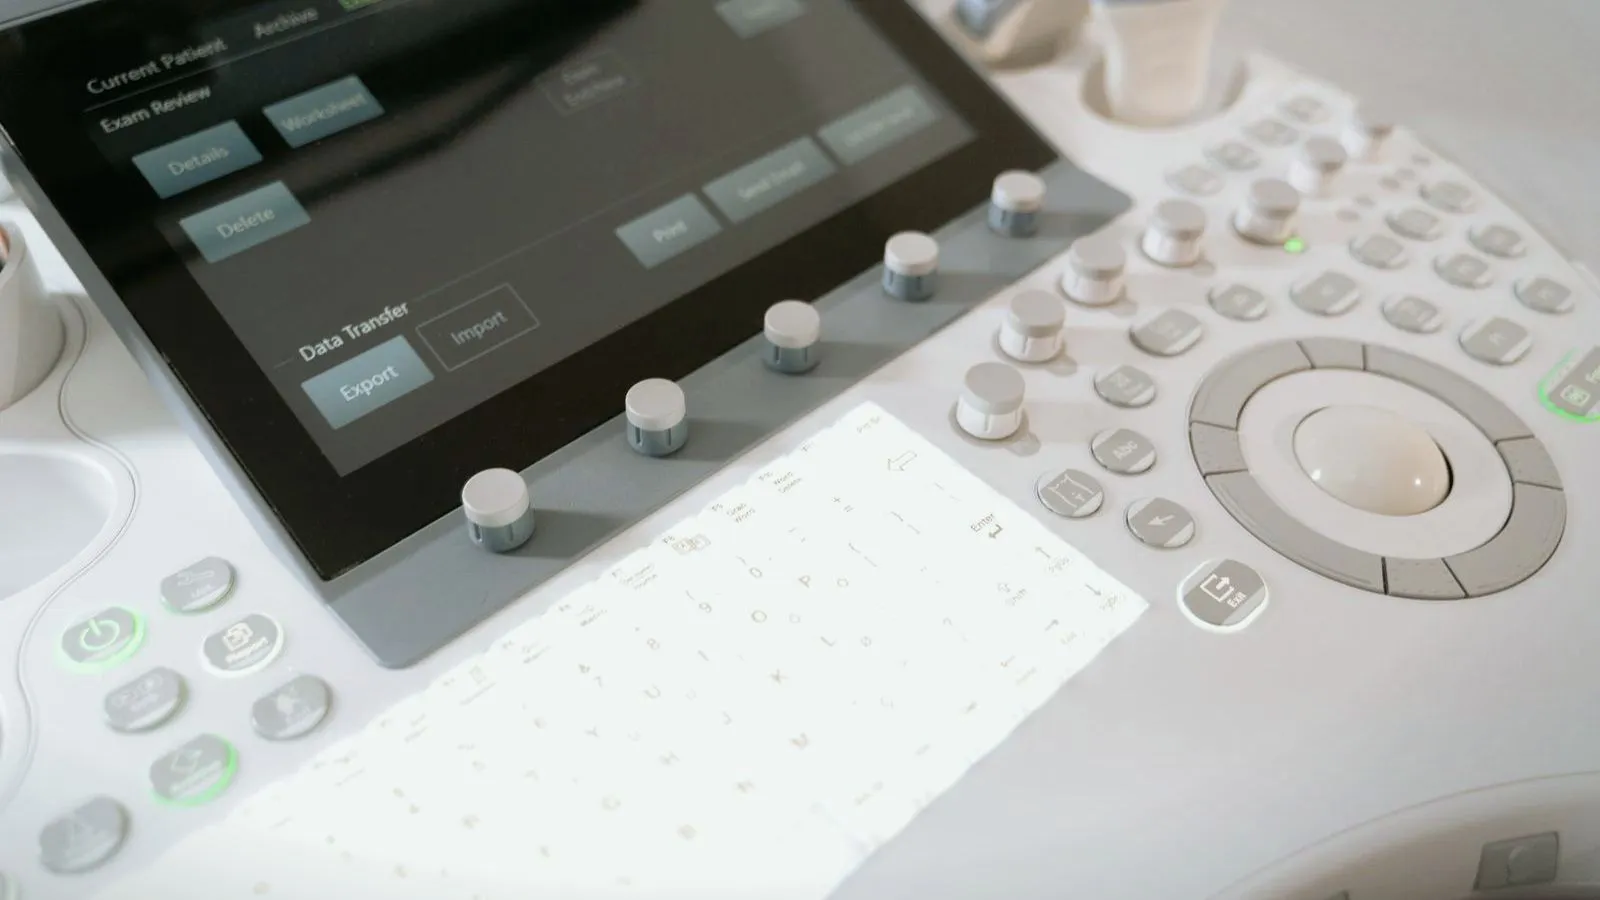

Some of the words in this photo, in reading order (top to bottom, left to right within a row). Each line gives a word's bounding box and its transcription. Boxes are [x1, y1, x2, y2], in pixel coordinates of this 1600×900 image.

[253, 7, 319, 39] Archive
[86, 59, 161, 95] Current
[161, 37, 228, 70] Patient
[100, 106, 150, 135] Exam
[150, 85, 211, 116] Review
[280, 91, 368, 133] Worksheet
[168, 145, 230, 176] Details
[216, 206, 276, 239] Delete
[298, 334, 344, 363] Data
[342, 301, 410, 342] Transfer
[450, 310, 509, 347] Import
[339, 364, 400, 403] Export
[970, 512, 995, 532] Enter
[797, 574, 812, 589] P
